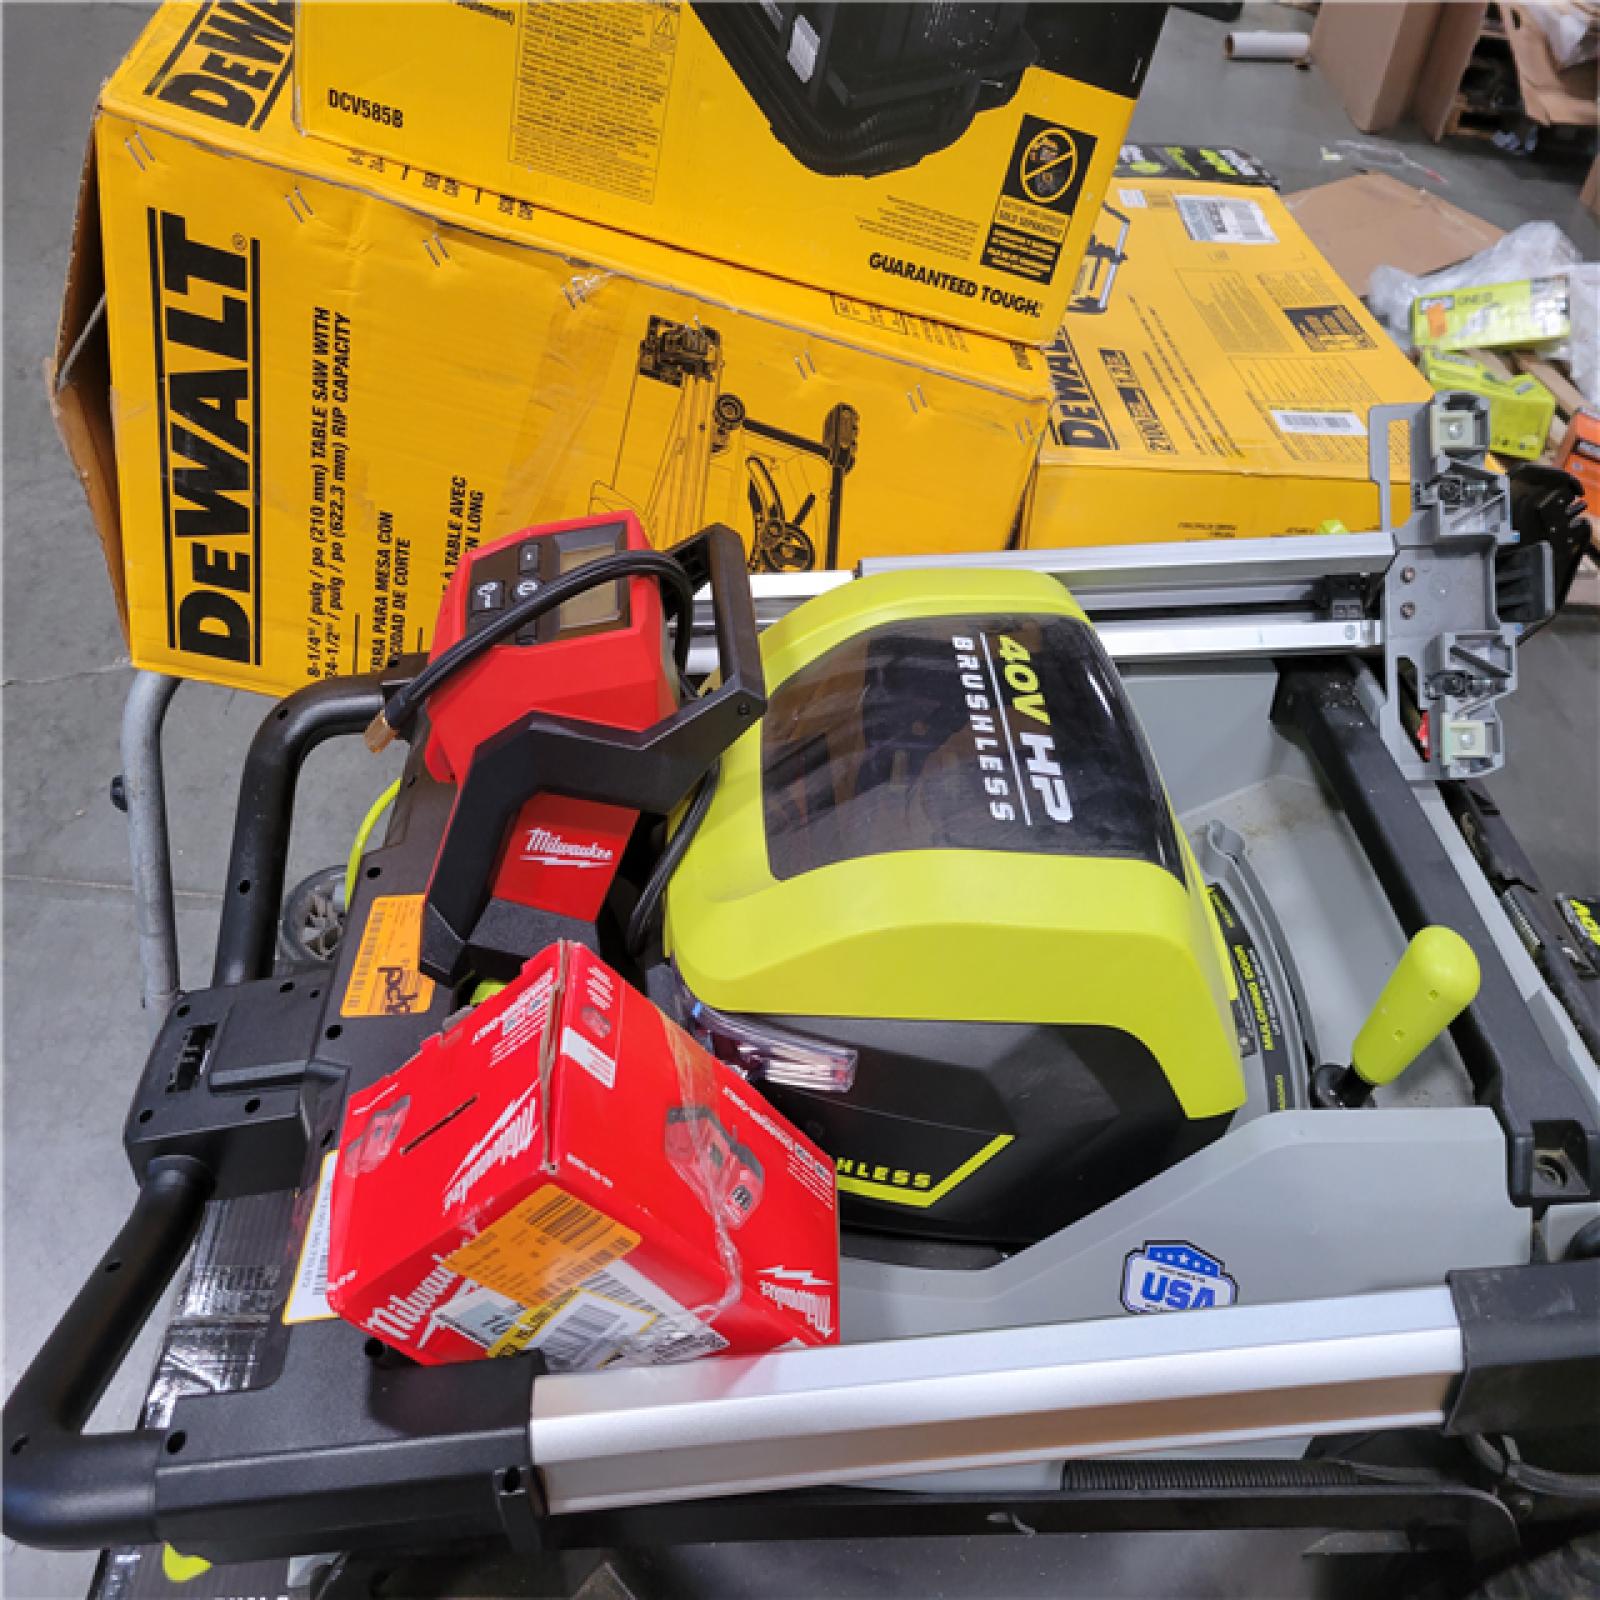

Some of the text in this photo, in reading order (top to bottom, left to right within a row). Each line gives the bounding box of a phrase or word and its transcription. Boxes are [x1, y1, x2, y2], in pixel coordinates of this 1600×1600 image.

[327, 87, 404, 128] DCV585B
[869, 252, 979, 298] GUARANTEED
[313, 306, 330, 355] WITH
[333, 311, 351, 403] CAPACITY
[312, 359, 329, 402] SAW
[160, 209, 251, 665] DEWALT
[310, 405, 328, 458] TABLE
[332, 406, 347, 438] RIP
[450, 475, 468, 518] AVEC
[467, 489, 484, 533] LONG
[377, 510, 393, 545] CON
[445, 519, 463, 566] TABLE
[312, 547, 326, 568] po
[375, 549, 390, 591] MESA
[395, 537, 410, 586] CORTE
[372, 597, 388, 634] PARA
[392, 589, 407, 611] DE
[952, 634, 1016, 821] BRUSHLESS
[998, 634, 1073, 823] 40V HP
[1142, 1271, 1216, 1310] USA
